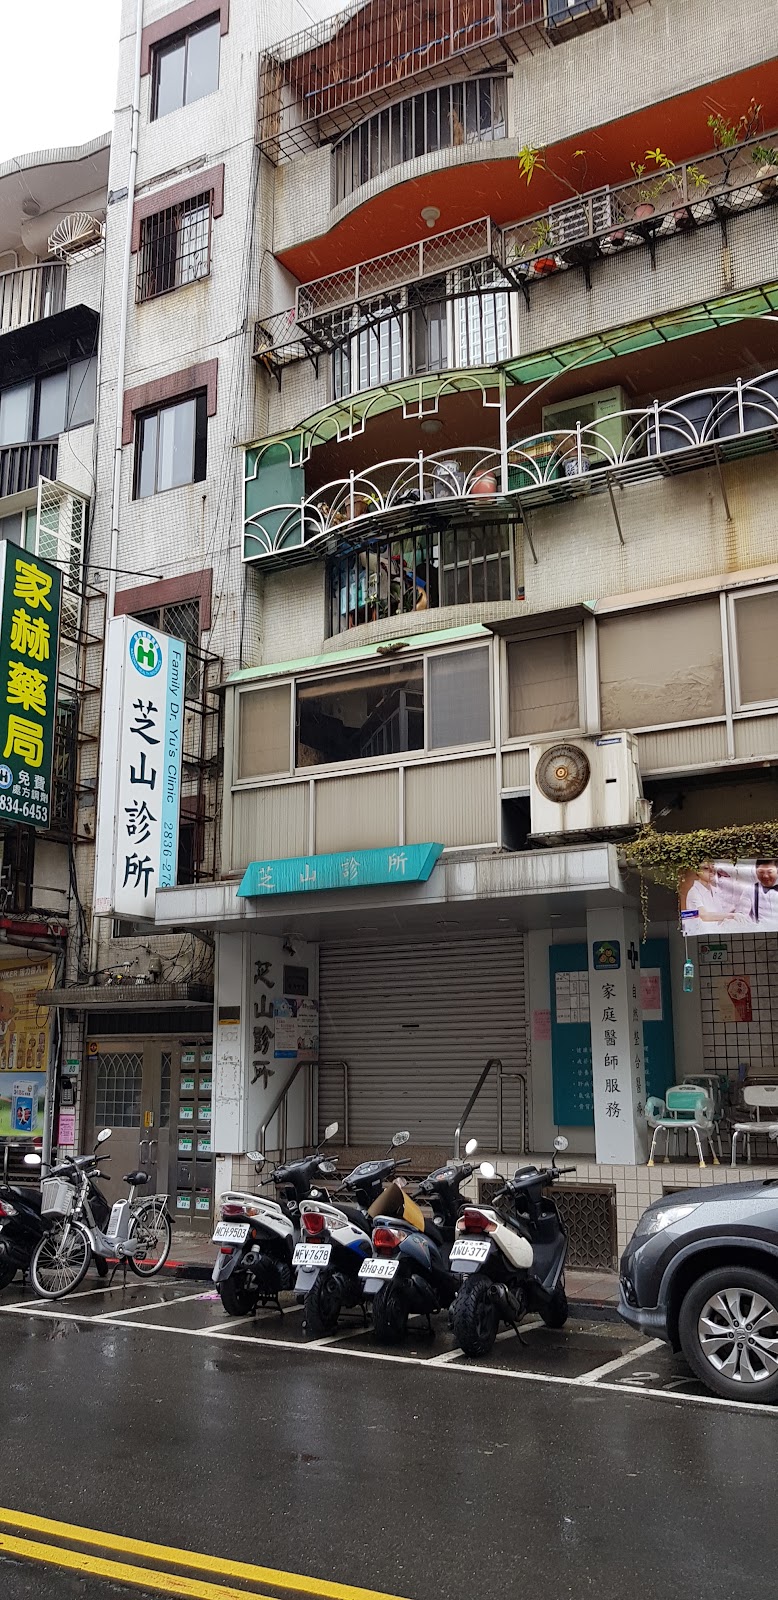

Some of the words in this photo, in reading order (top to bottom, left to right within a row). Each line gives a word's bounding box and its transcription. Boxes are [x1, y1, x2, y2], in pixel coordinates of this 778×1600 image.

[4, 558, 52, 769] 家赫藥局
[169, 650, 182, 698] Family
[169, 703, 180, 721] Dr.
[168, 729, 179, 758] Yu's
[18, 770, 46, 792] 免費
[123, 698, 161, 898] 芝山診所
[167, 764, 177, 804] Clinic
[258, 852, 408, 889] 芝山診所
[712, 952, 723, 960] 82
[601, 983, 621, 1118] 家庭醫師服務
[294, 1249, 329, 1261] MFV-7678
